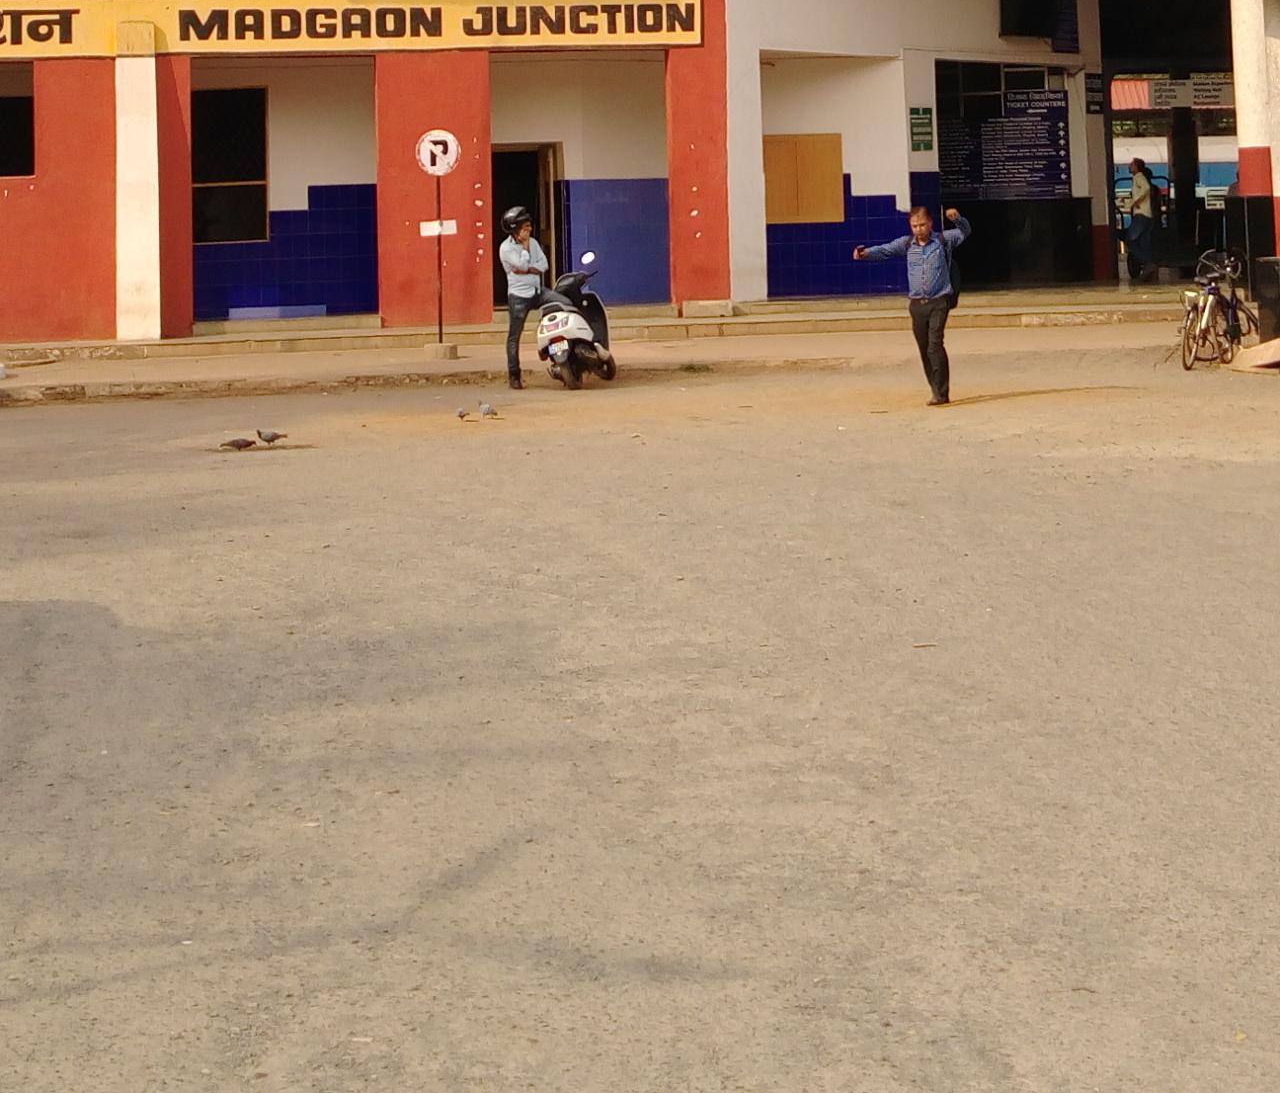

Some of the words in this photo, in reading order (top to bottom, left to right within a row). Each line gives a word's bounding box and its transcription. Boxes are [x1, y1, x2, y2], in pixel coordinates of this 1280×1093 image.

[178, 7, 443, 42] MADGAON
[462, 2, 696, 38] JUNCTION
[1030, 100, 1066, 108] COUNTERS
